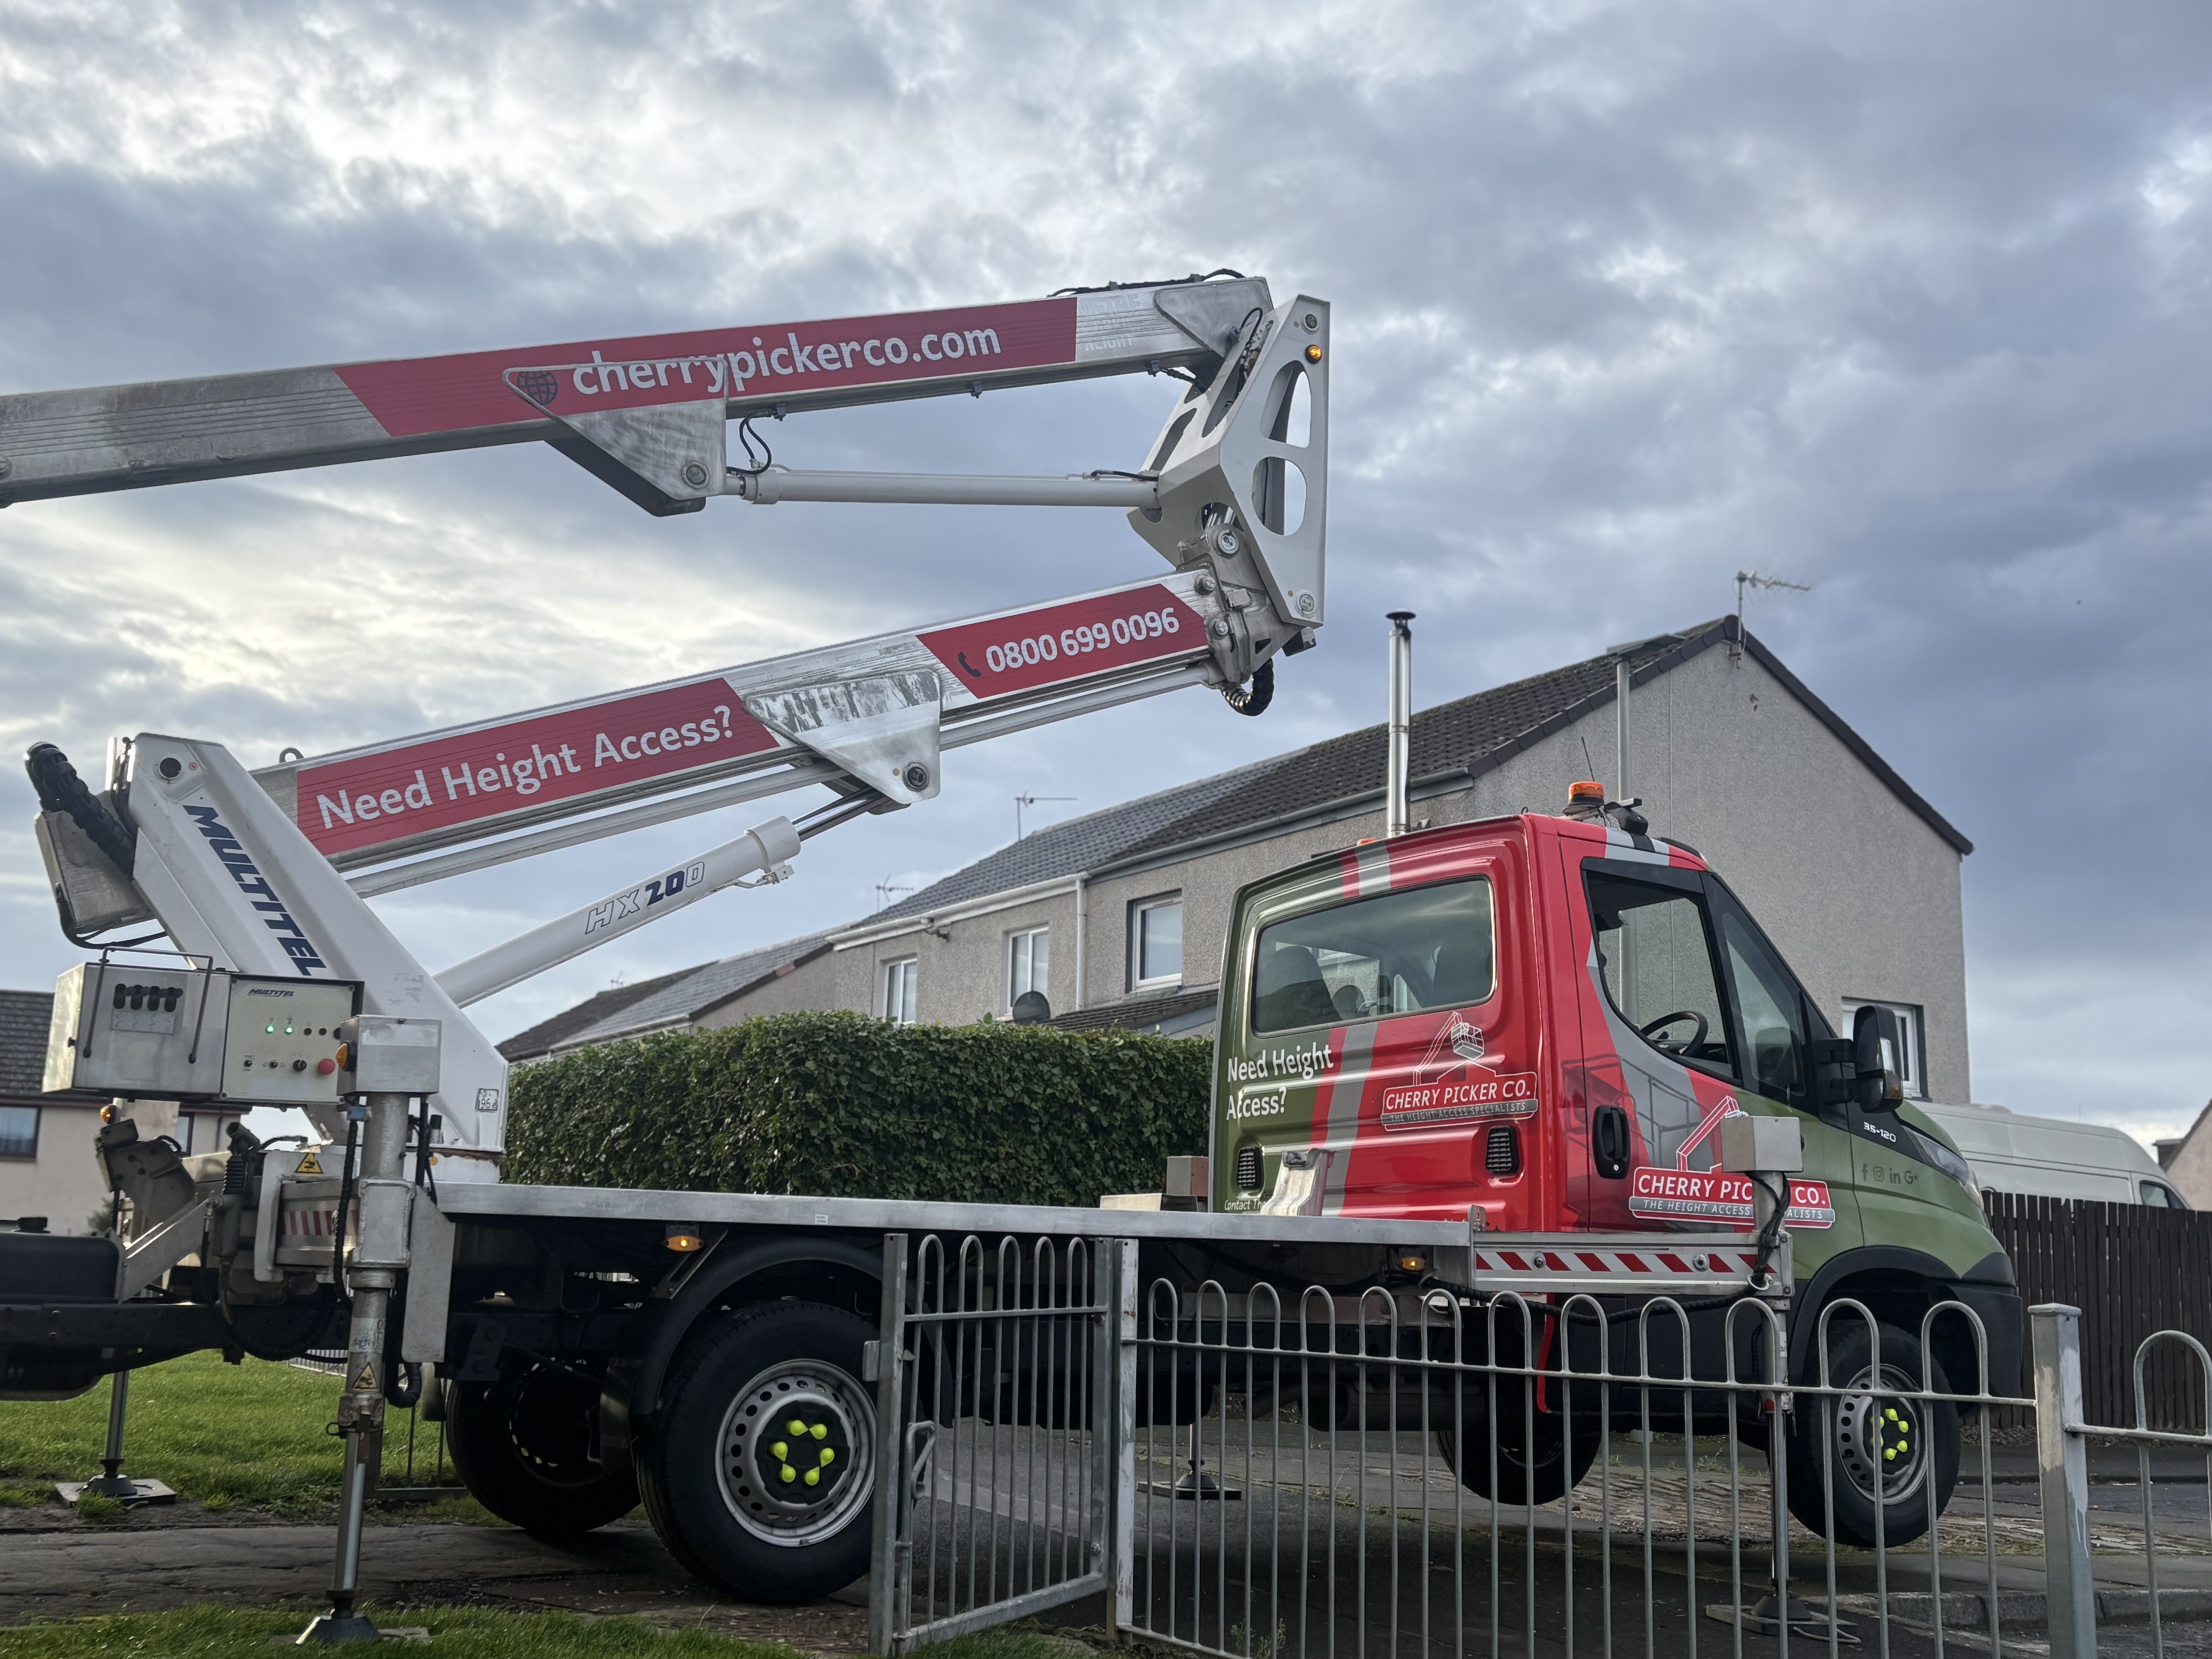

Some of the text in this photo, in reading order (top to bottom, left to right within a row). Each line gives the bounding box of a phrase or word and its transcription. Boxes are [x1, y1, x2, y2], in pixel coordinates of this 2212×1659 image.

[573, 328, 1001, 394] cherrypickerco.com
[986, 608, 1180, 672] 0800 699 0096
[317, 705, 733, 829] Need Height Access?
[182, 805, 326, 976] MULTITEL
[1228, 1042, 1334, 1082] Need Height
[1226, 1086, 1287, 1120] Access?
[1386, 1080, 1531, 1110] CHERRY PICKER CO.
[1407, 1111, 1435, 1121] HEIGHT
[1439, 1108, 1468, 1118] ACCESS
[1471, 1102, 1526, 1114] SPECIALISTS
[1863, 1121, 1896, 1142] 35-120
[1224, 1199, 1251, 1211] Contact
[1638, 1175, 1826, 1205] CHERRY PIC CO.
[1644, 1200, 1822, 1219] THE HEIGHT ACCESS ALISTS
